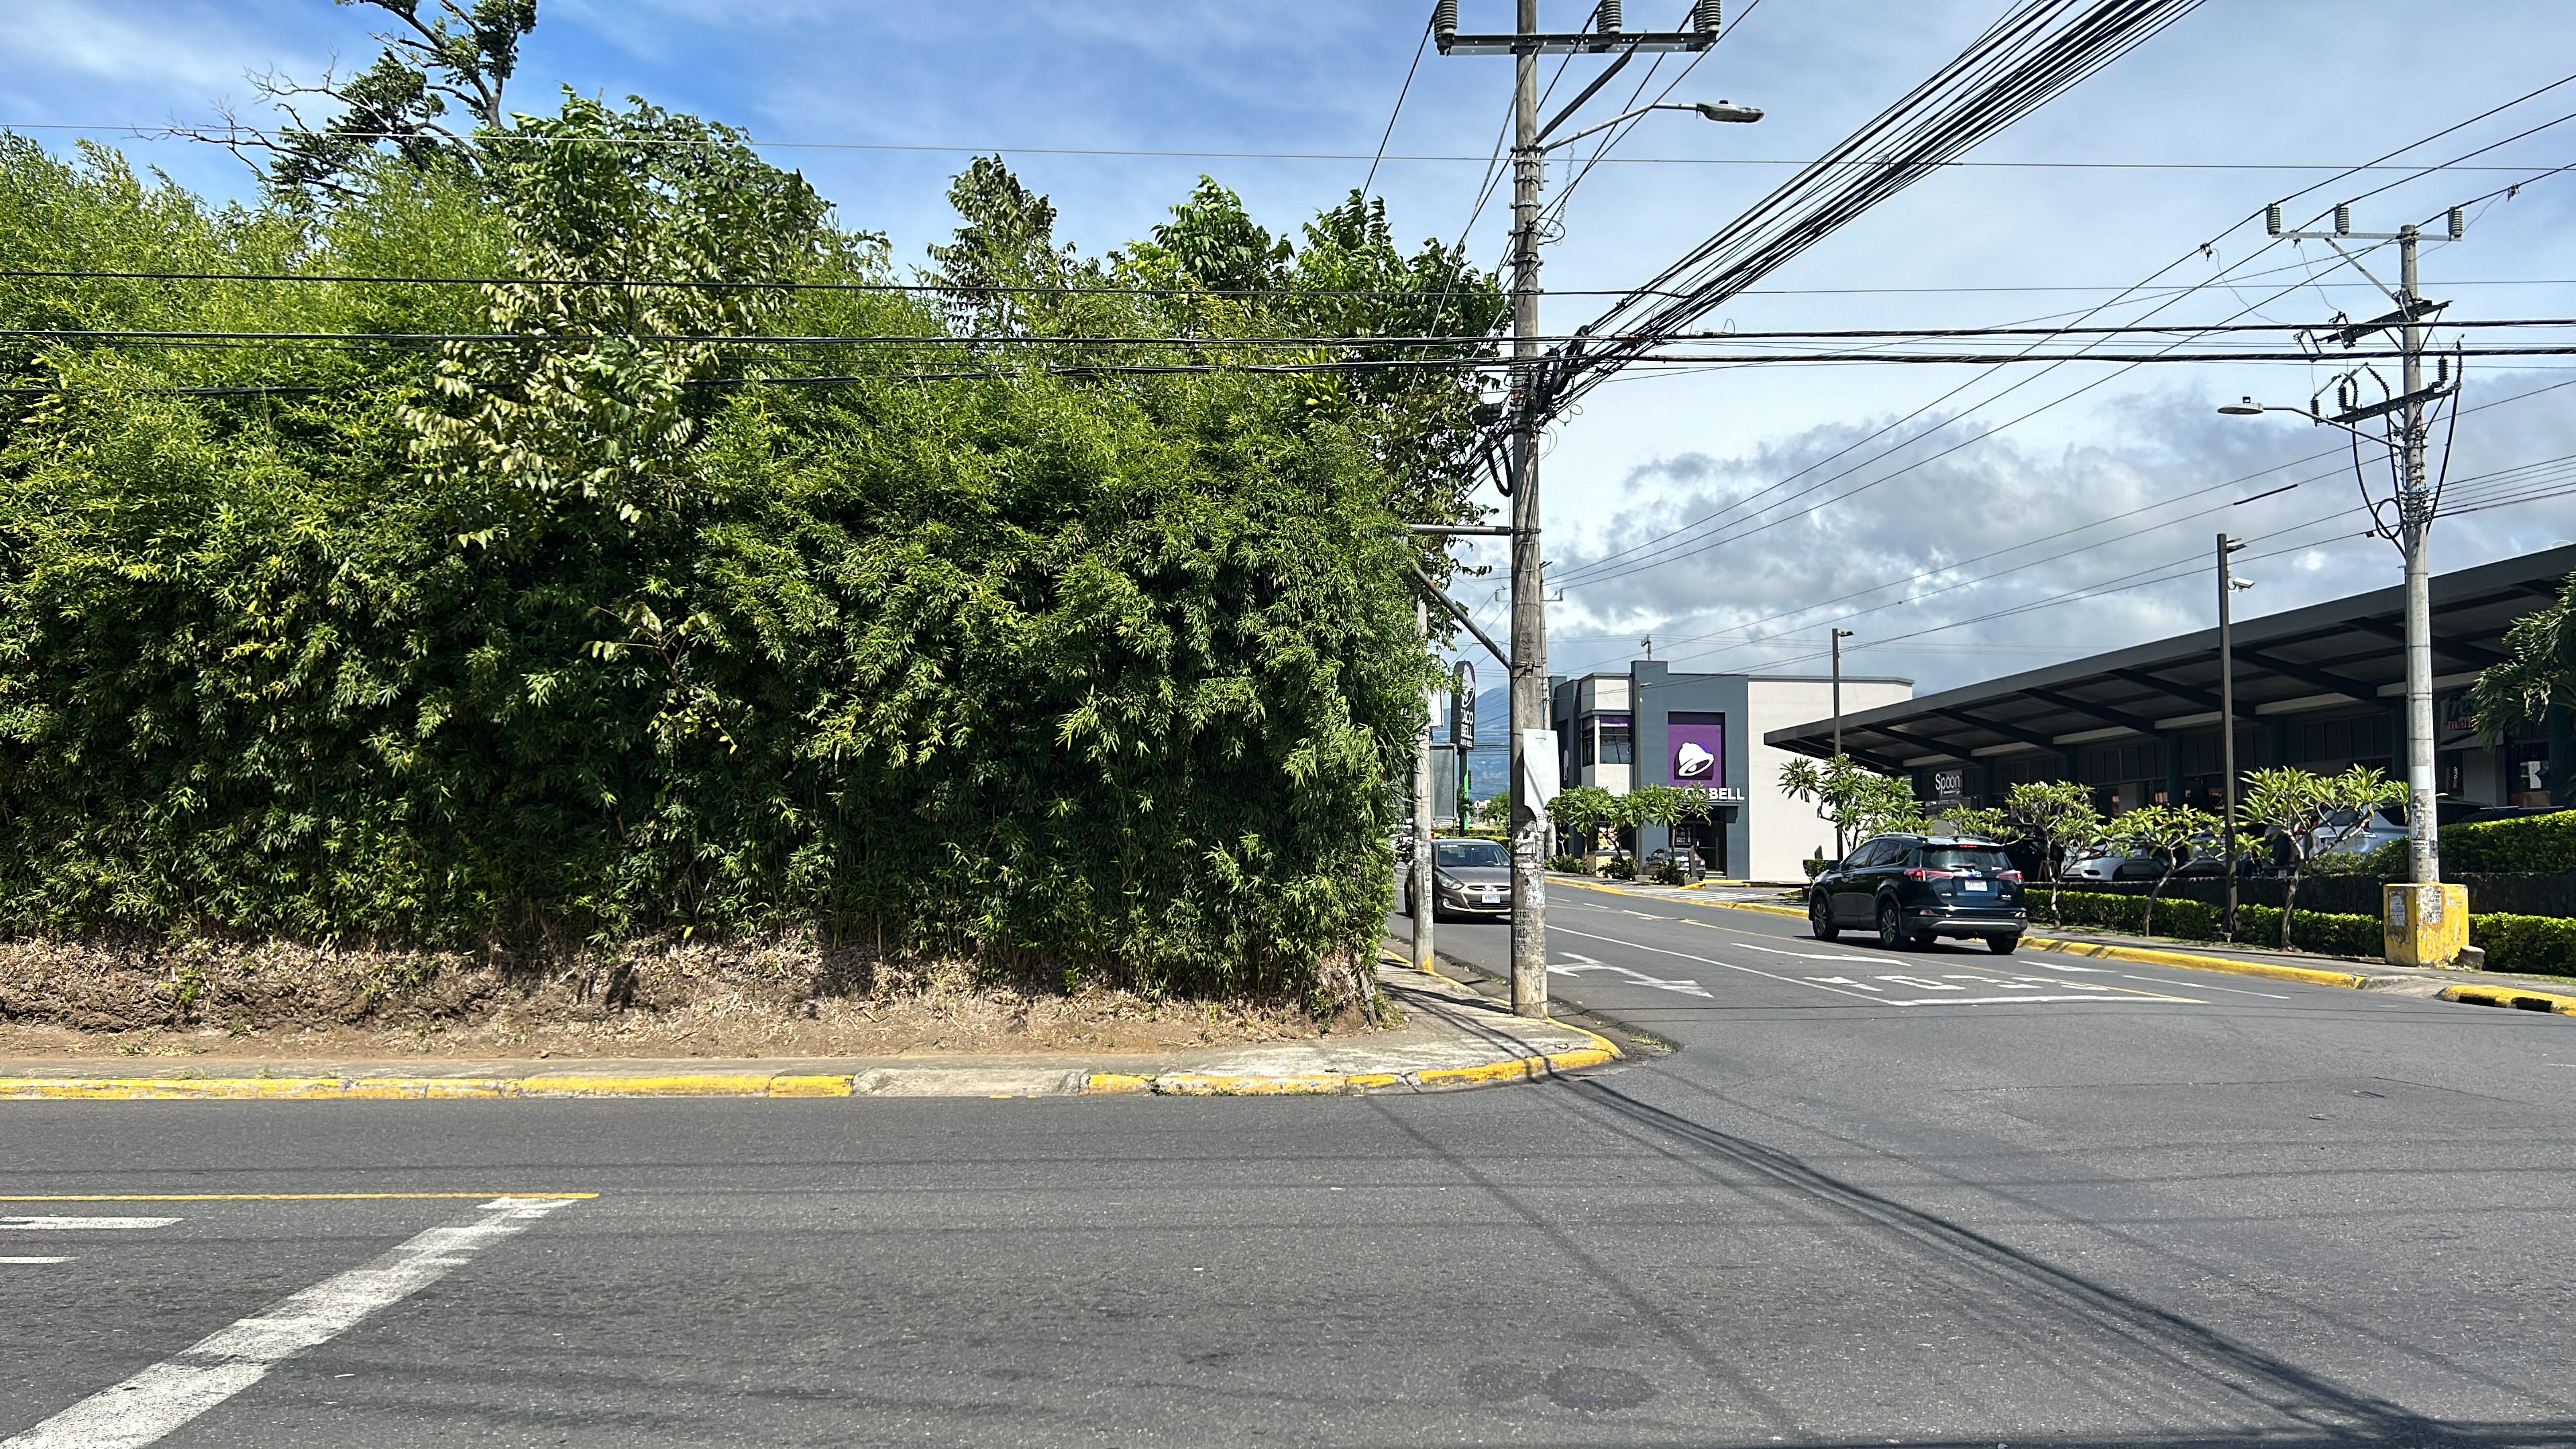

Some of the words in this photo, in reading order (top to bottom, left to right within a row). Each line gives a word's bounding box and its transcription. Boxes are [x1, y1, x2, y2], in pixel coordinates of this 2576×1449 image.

[1460, 708, 1474, 725] TACO
[1460, 723, 1473, 739] BELL
[1935, 773, 1960, 795] Spoon
[1709, 788, 1745, 800] BELL
